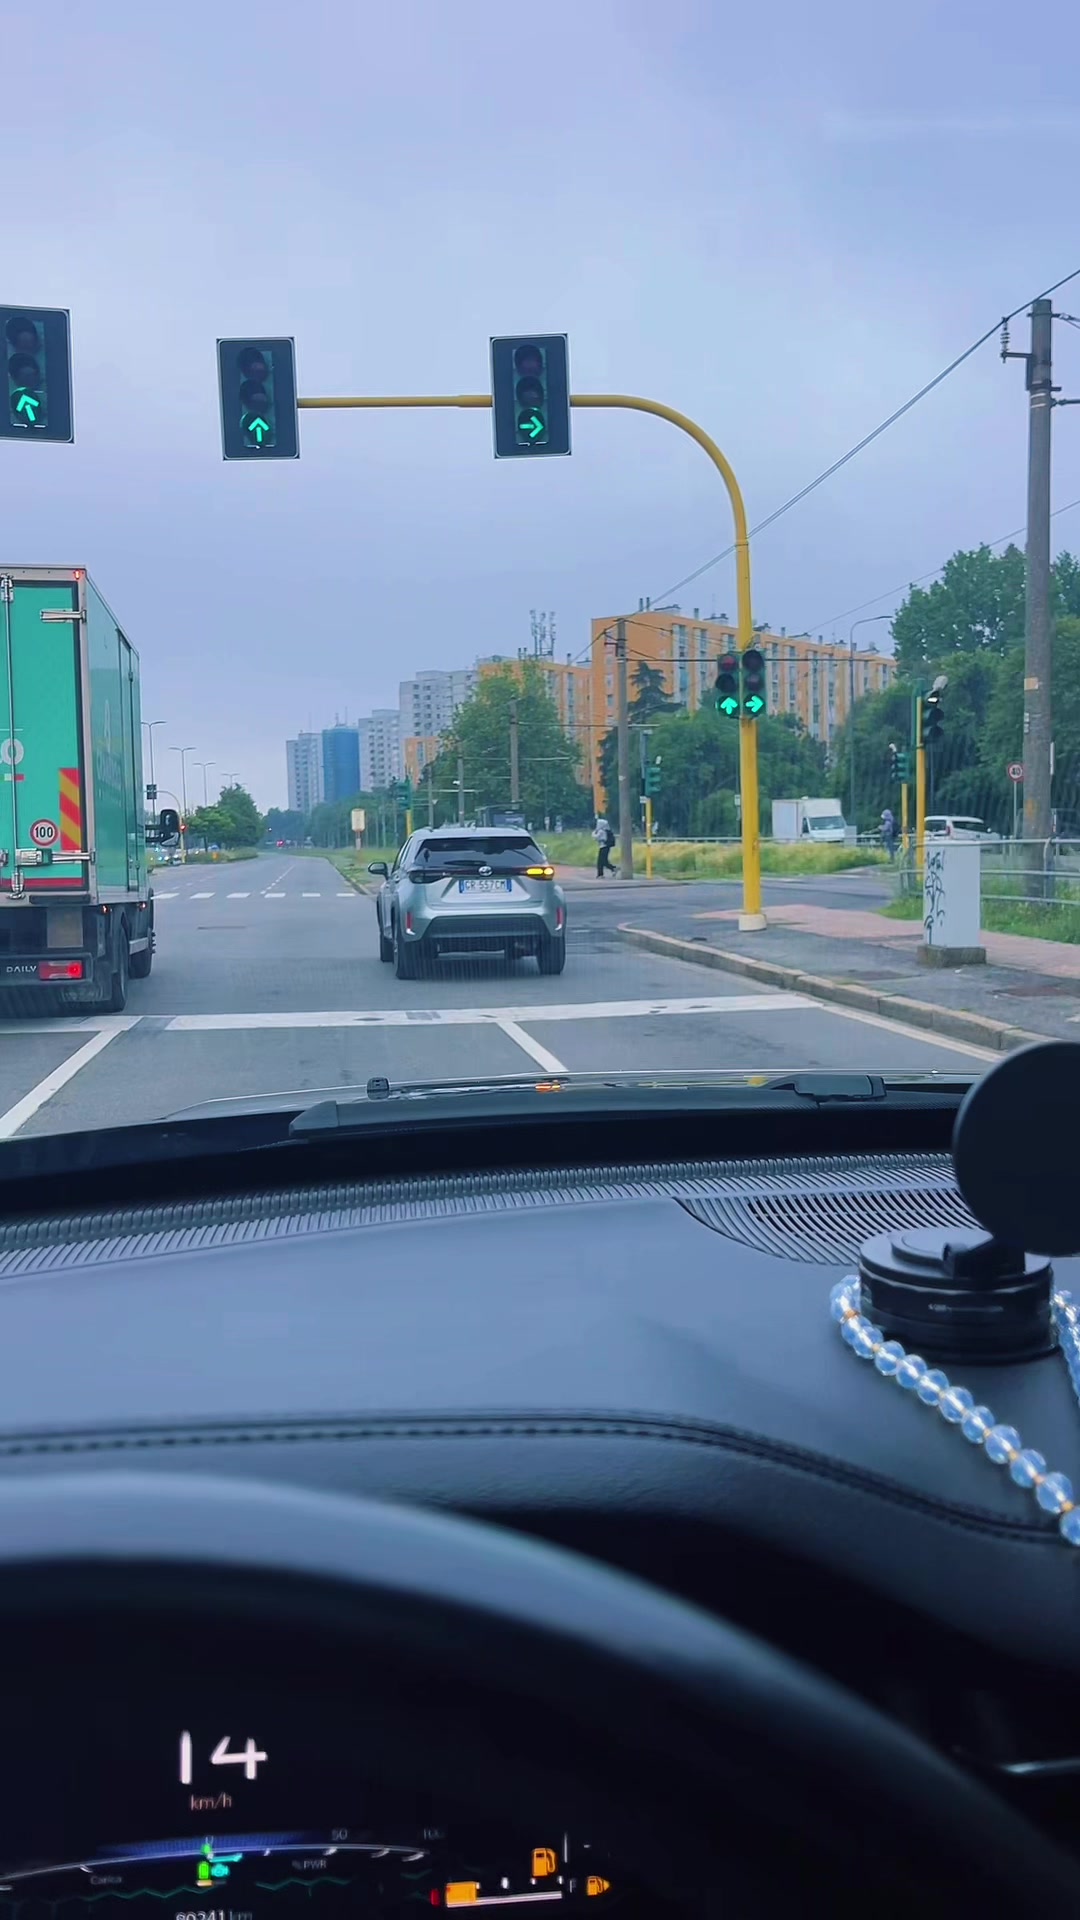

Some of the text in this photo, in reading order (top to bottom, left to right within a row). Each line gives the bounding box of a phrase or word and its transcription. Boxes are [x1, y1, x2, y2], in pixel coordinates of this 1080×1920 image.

[0, 739, 24, 765] O
[35, 826, 53, 838] 100
[6, 965, 37, 973] DAILY
[180, 1729, 268, 1785] 14
[191, 1792, 232, 1810] km/h
